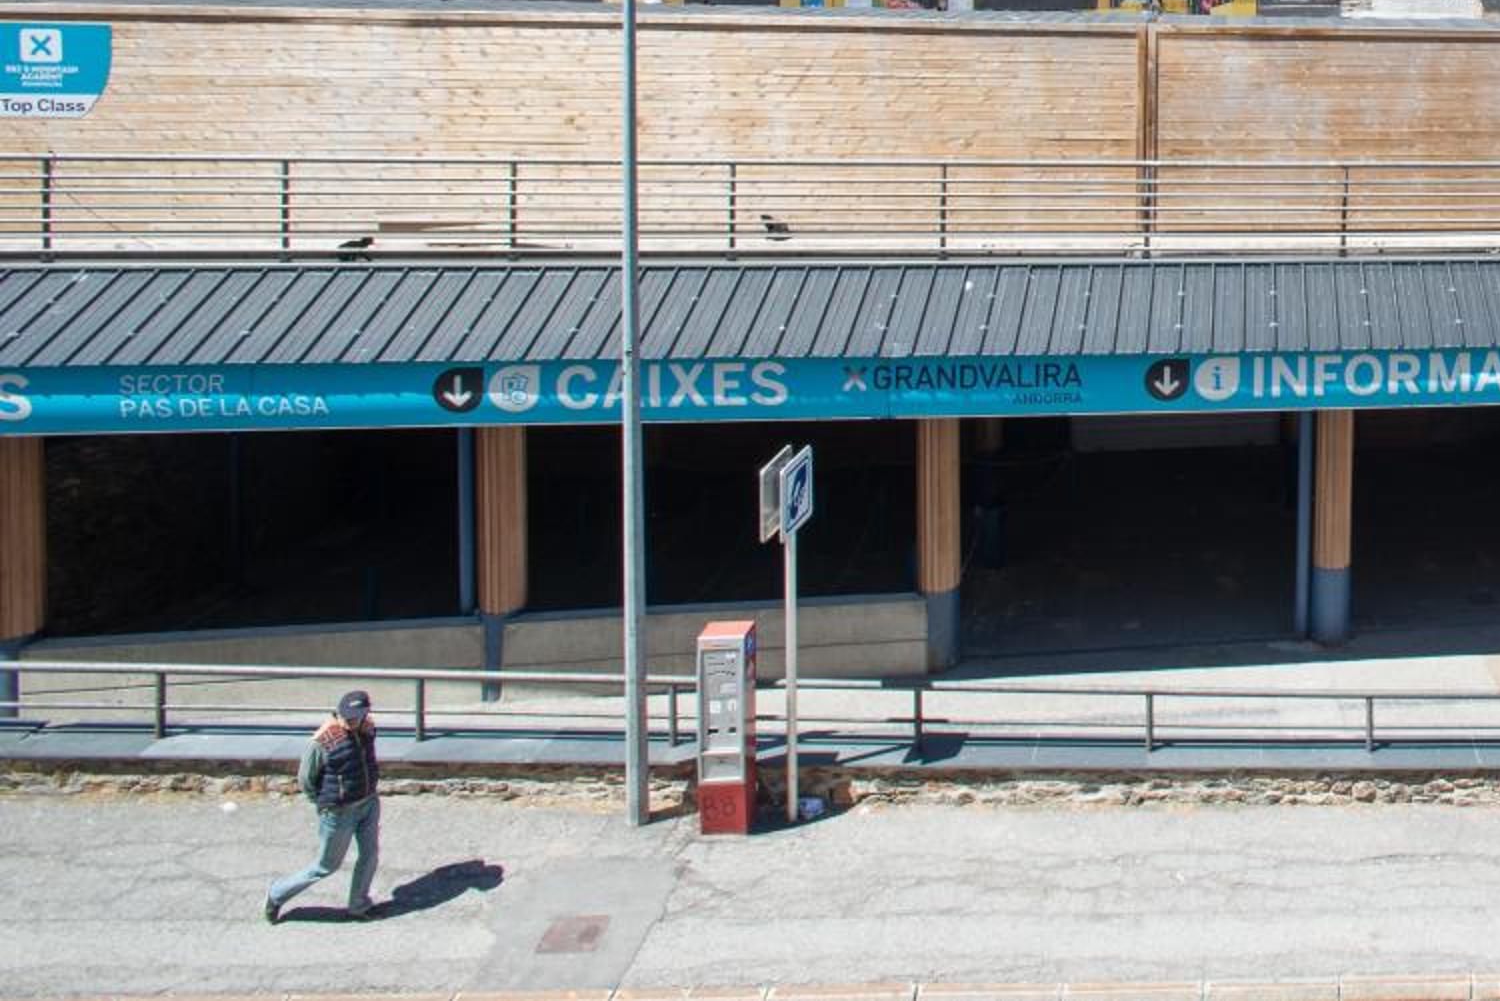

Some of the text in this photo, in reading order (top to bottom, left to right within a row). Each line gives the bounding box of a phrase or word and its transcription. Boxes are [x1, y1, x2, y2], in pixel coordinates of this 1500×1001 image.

[2, 98, 86, 114] Top Class
[119, 374, 225, 395] SECTOR
[556, 362, 789, 411] CAIXES
[872, 363, 1083, 391] GRANDVALIRA
[119, 395, 330, 419] PAS DE LA CASA
[1012, 392, 1083, 405] ANDORRA
